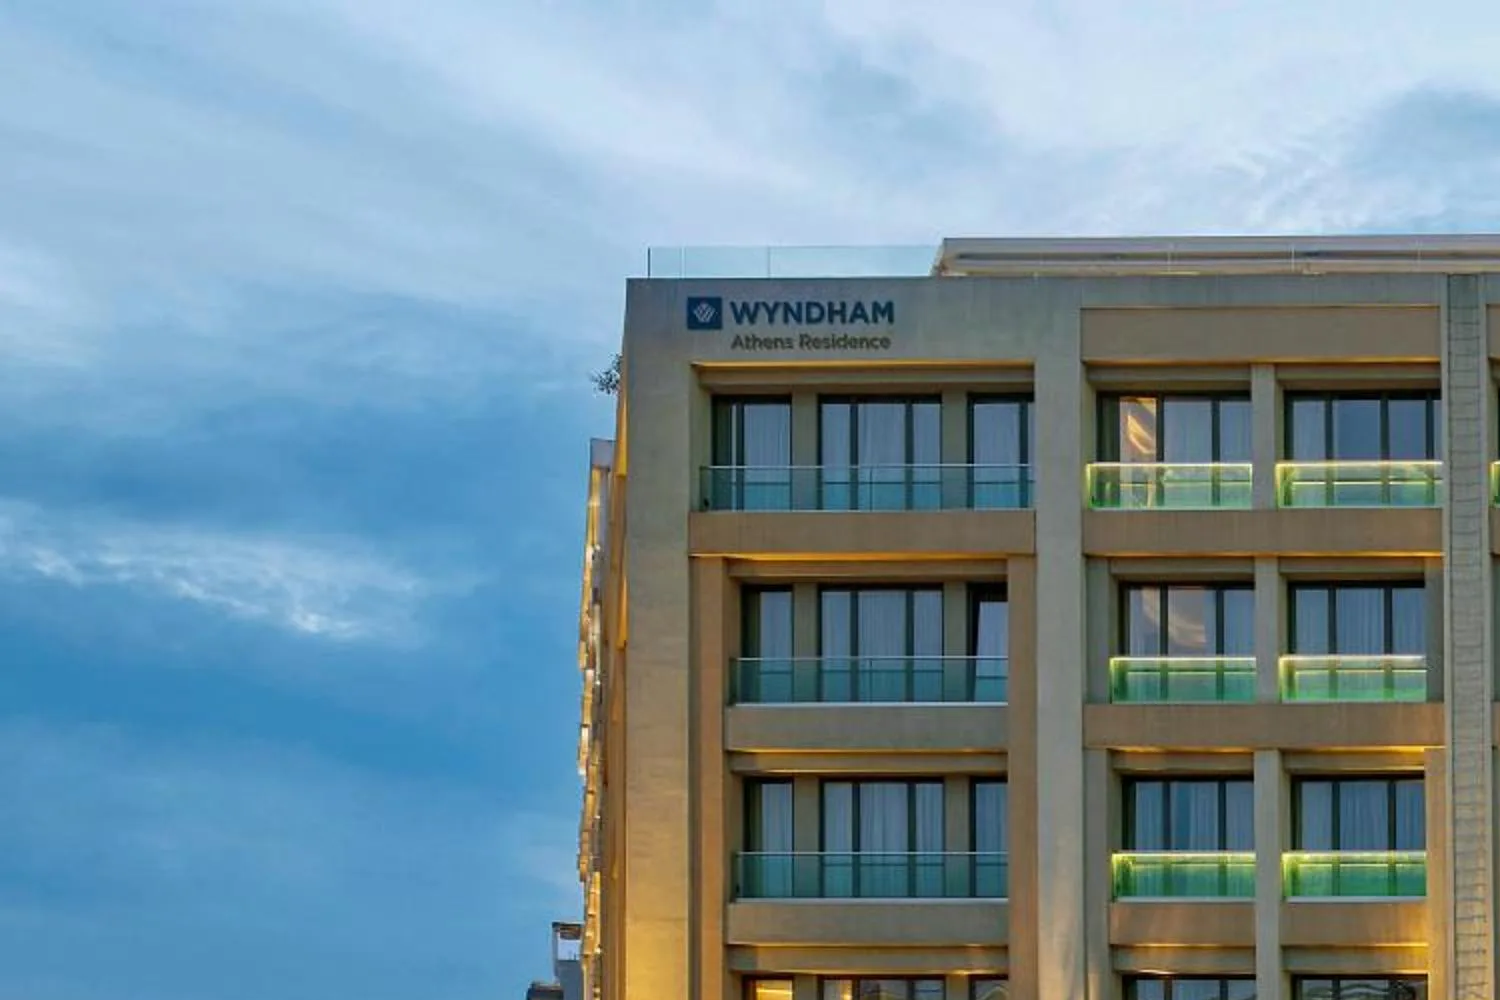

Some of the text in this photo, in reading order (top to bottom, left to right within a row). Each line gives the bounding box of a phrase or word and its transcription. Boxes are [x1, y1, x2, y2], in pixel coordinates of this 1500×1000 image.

[730, 301, 895, 325] WYNDHAM
[730, 332, 892, 350] Athens Residence
